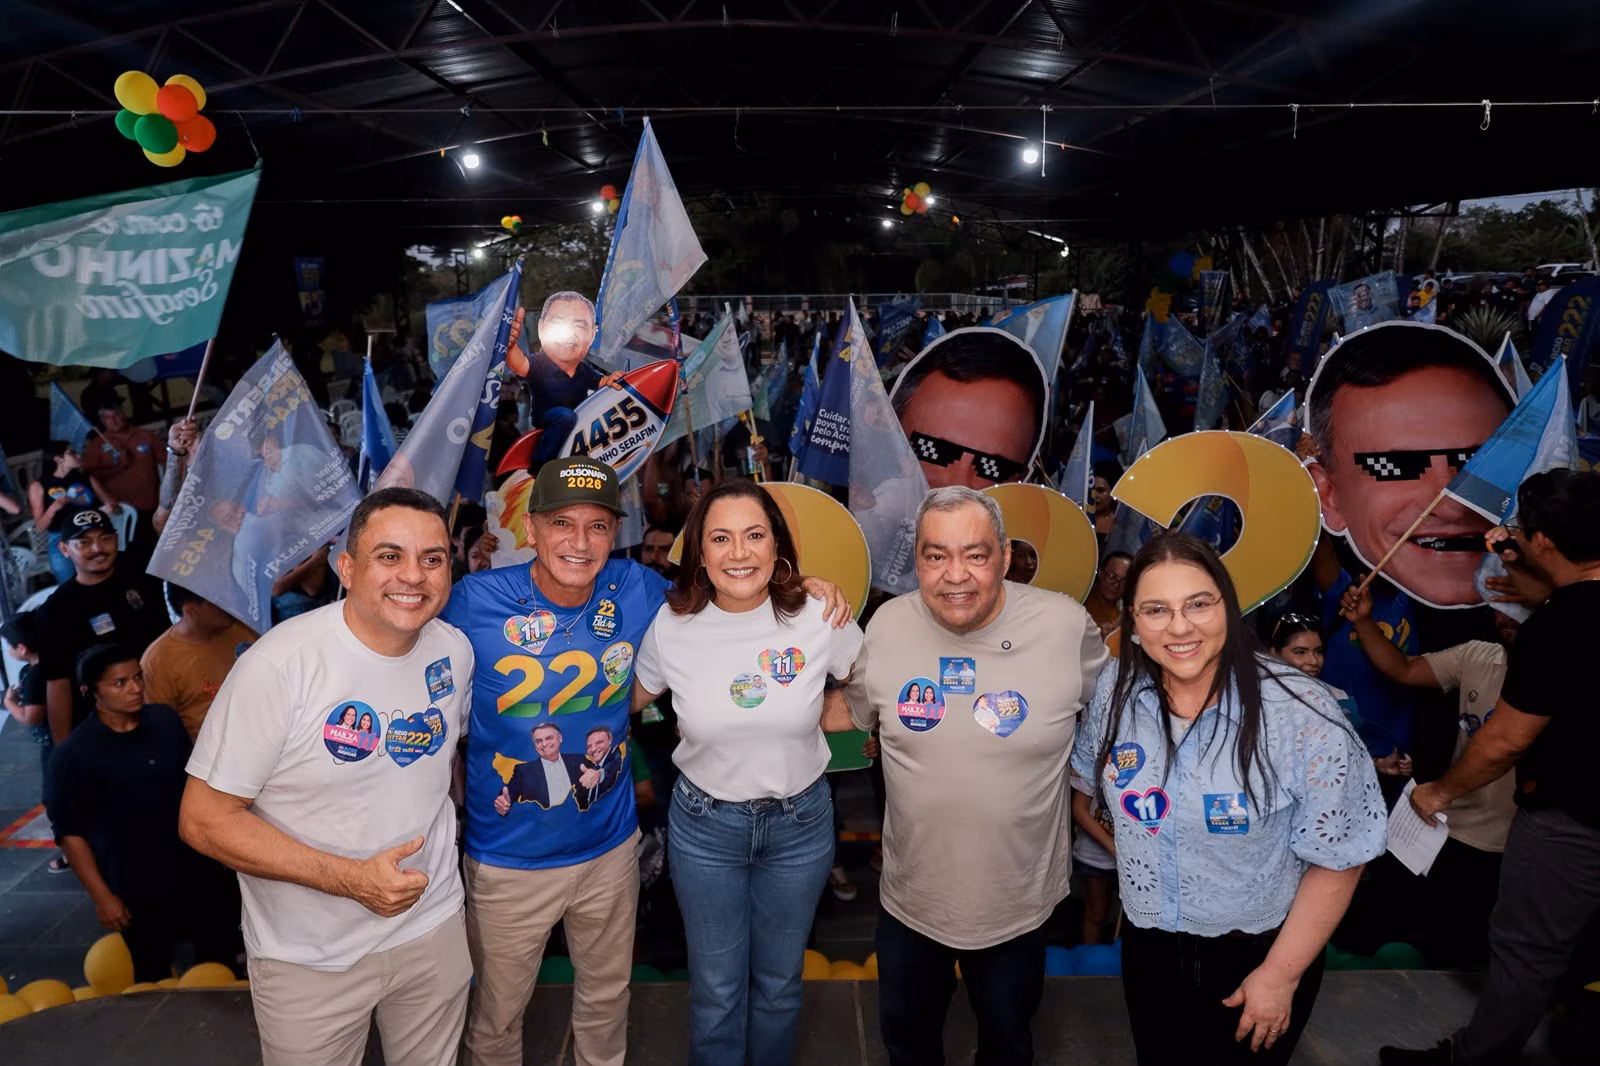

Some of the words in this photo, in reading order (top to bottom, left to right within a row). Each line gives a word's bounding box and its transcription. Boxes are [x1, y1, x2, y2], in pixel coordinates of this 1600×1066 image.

[818, 408, 847, 425] Cuidar
[570, 395, 647, 457] 4455
[813, 425, 833, 438] pelo
[815, 418, 839, 432] povo,
[619, 423, 658, 454] SERAFIM
[810, 432, 850, 454] compr
[560, 467, 608, 482] BOLSONARO
[567, 476, 602, 491] 2026
[597, 601, 615, 617] 22
[520, 619, 541, 641] 11
[772, 655, 792, 674] 11
[901, 705, 924, 715] MAILZA
[999, 706, 1020, 717] 222
[329, 728, 358, 742] MAILZA
[406, 731, 431, 746] 222
[1118, 758, 1137, 769] 222
[1133, 794, 1157, 820] 11
